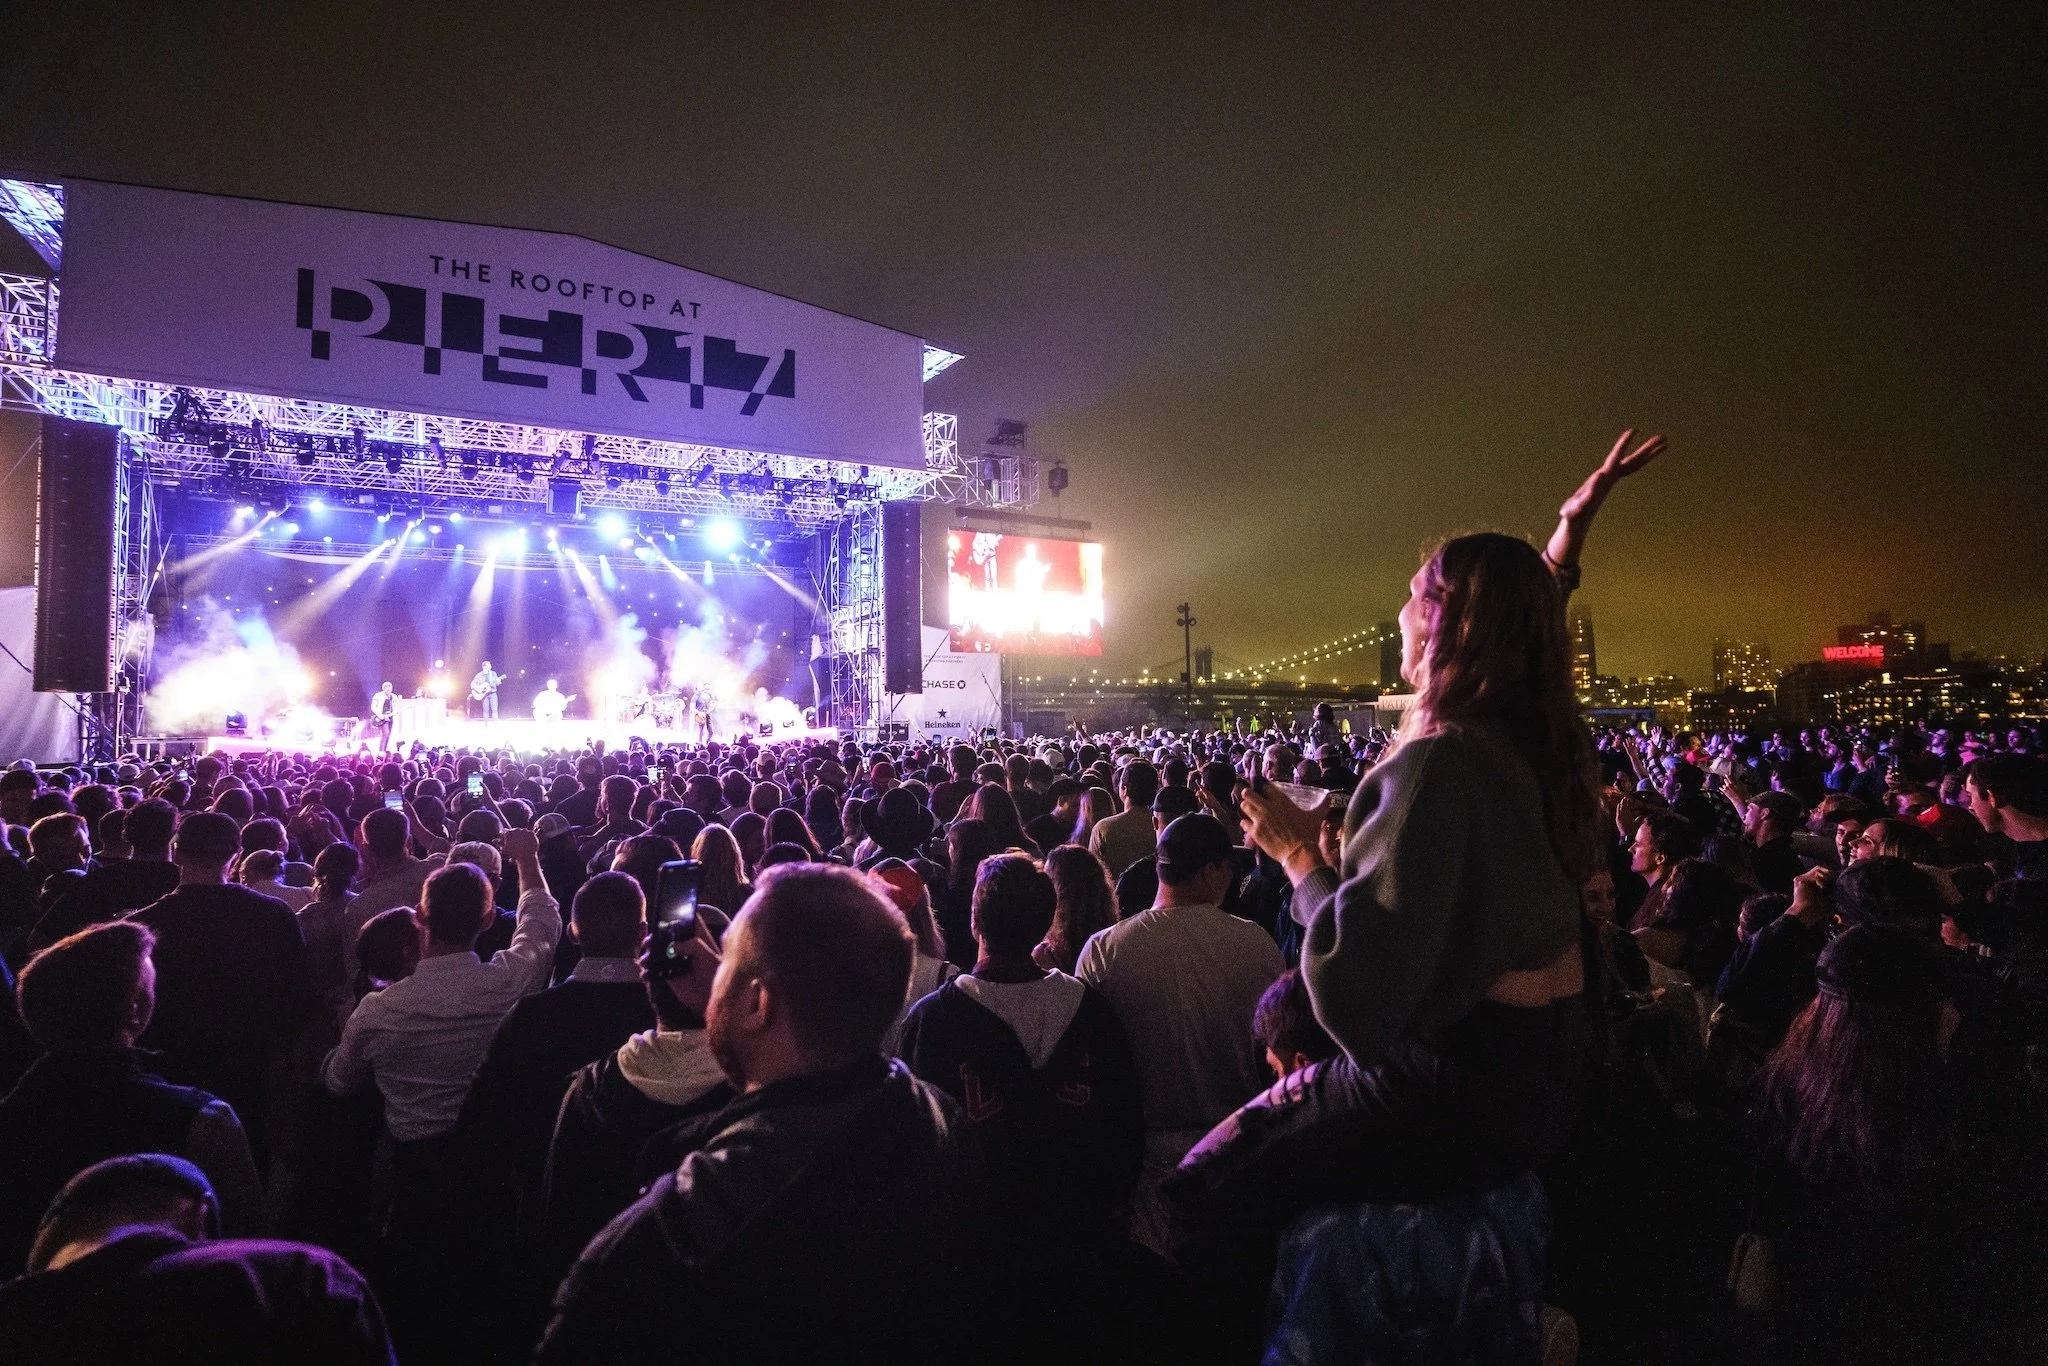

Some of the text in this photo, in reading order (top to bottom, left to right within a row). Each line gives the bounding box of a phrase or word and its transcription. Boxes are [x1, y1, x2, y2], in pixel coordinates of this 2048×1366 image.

[429, 254, 701, 320] THE ROOFTOP AT
[1823, 645, 1884, 660] WELCOME
[922, 680, 955, 689] CHASE
[924, 721, 961, 729] Heineken
